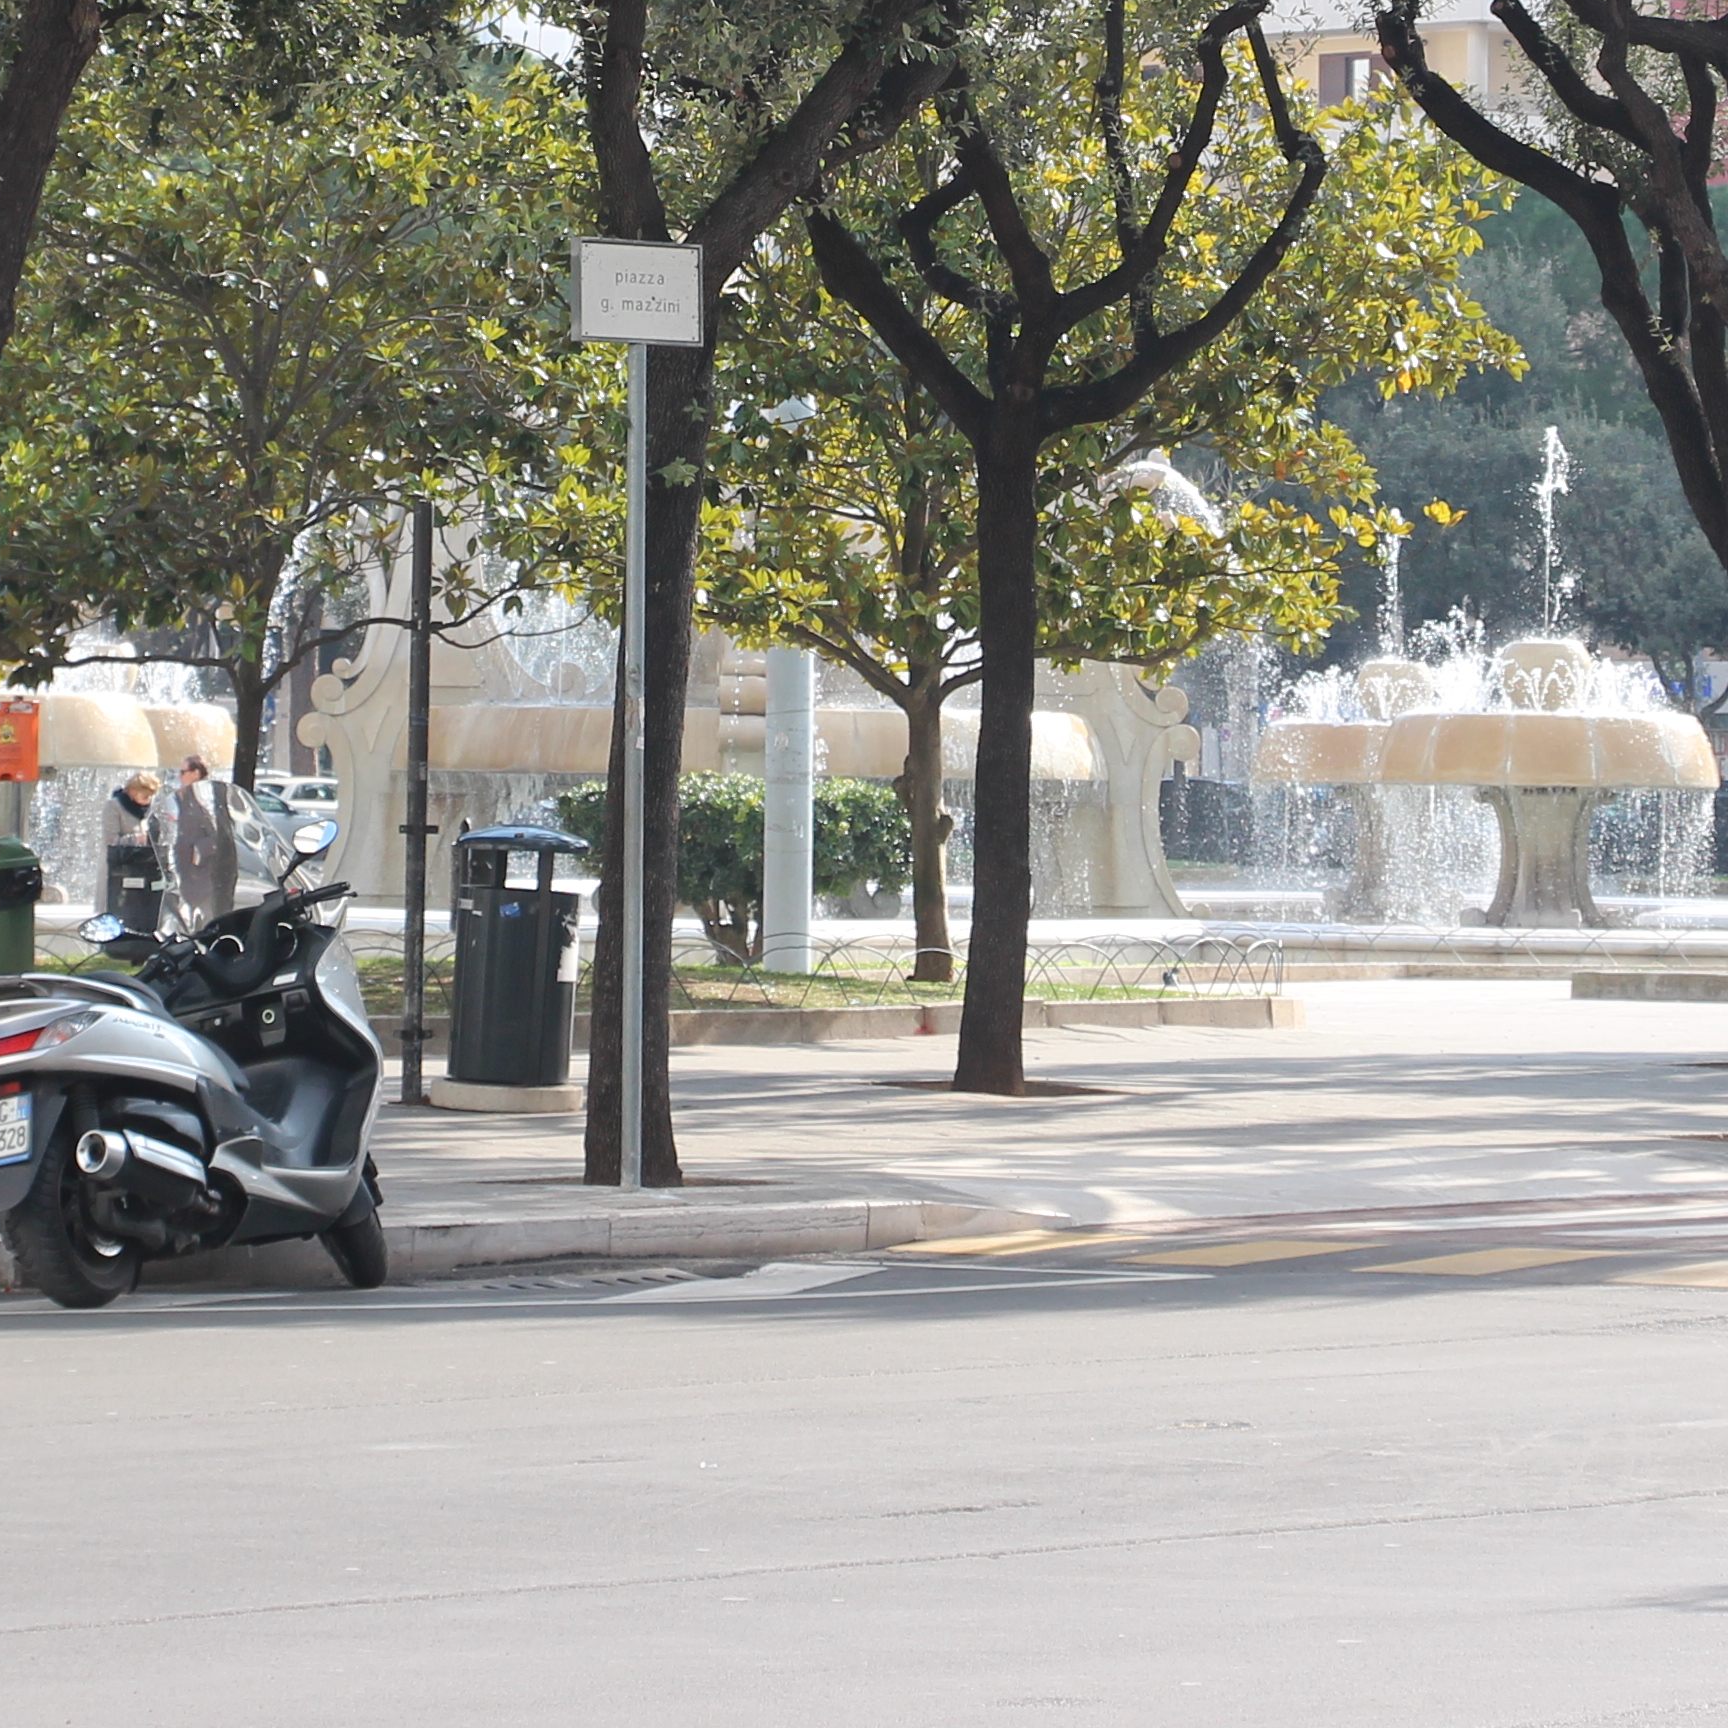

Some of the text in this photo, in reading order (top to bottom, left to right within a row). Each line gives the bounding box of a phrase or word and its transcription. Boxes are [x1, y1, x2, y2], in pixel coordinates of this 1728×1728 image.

[615, 268, 666, 287] piazza
[600, 297, 681, 315] g. mazzini
